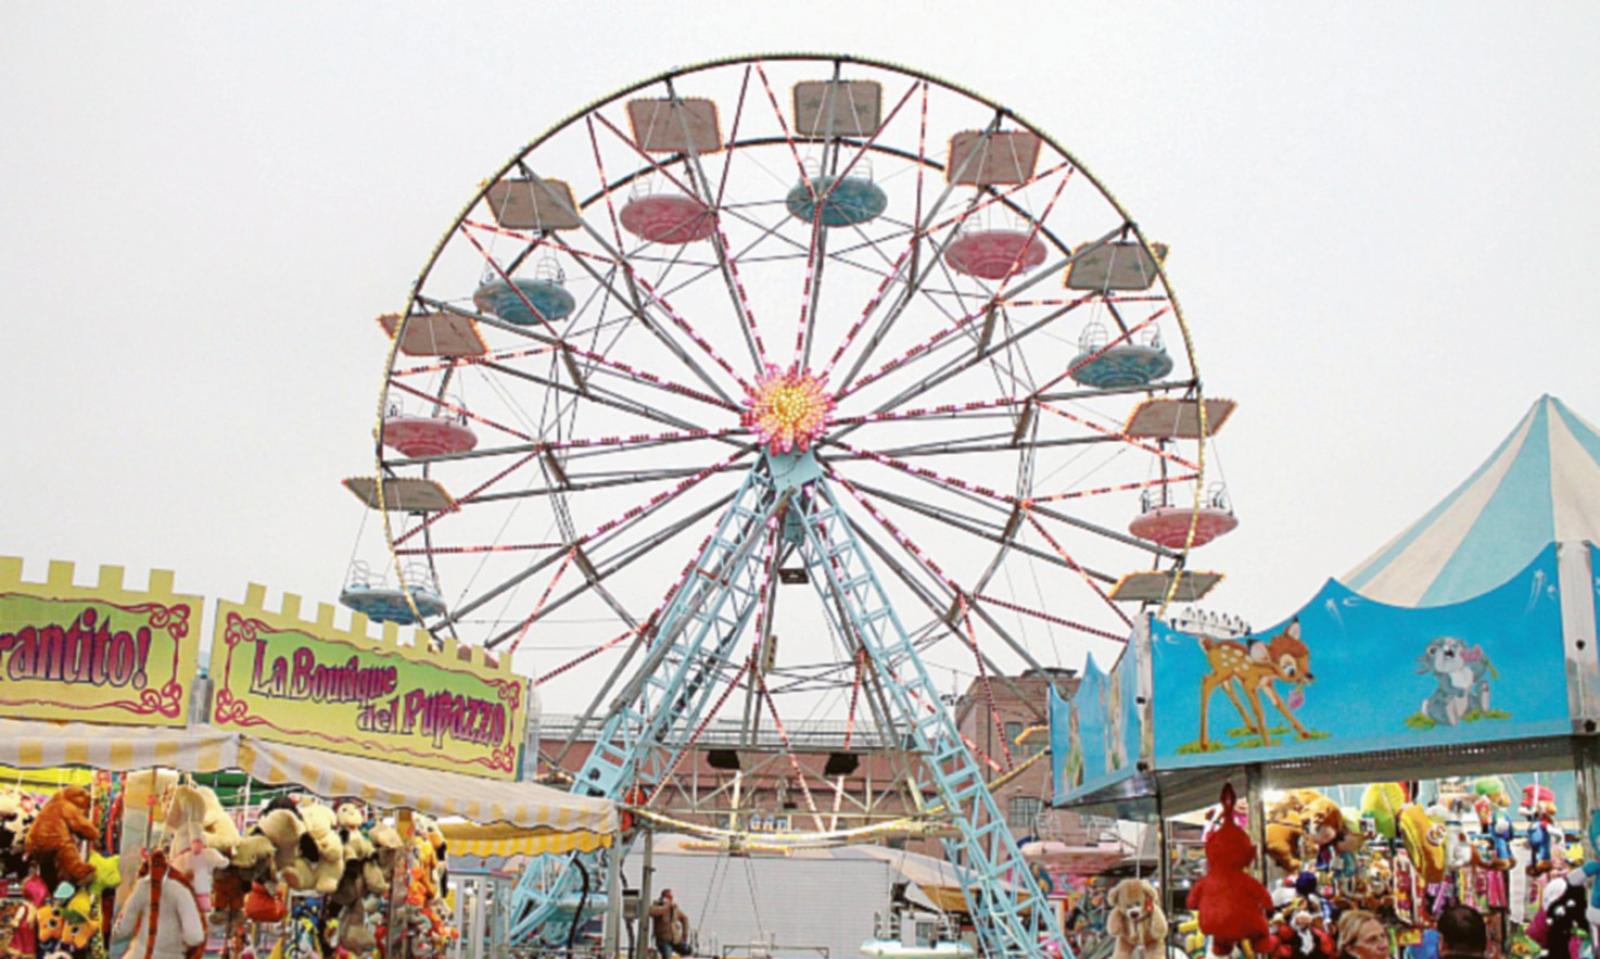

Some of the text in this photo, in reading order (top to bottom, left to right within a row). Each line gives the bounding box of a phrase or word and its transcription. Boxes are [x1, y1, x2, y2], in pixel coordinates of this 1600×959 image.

[249, 639, 398, 708] La Boutique
[356, 688, 506, 749] del Pupazzo
